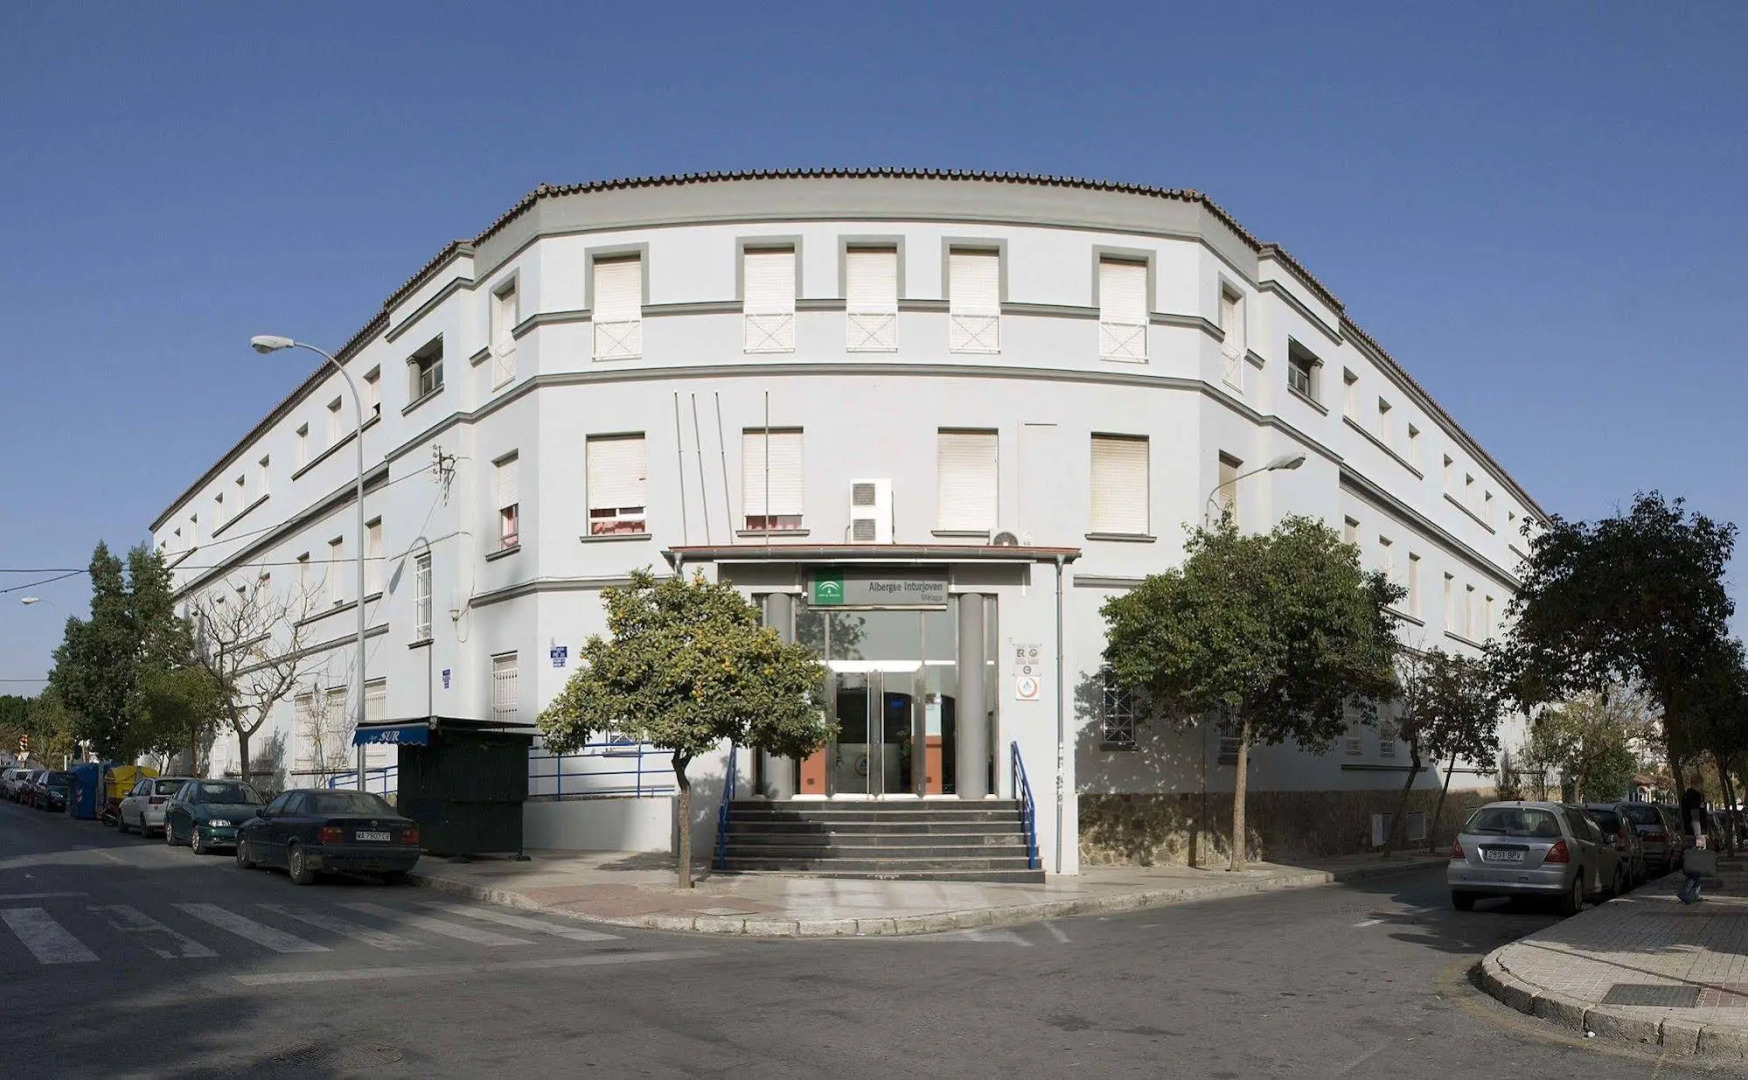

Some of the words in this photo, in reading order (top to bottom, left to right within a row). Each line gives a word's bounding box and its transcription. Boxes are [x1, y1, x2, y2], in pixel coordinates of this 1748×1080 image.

[868, 582, 902, 593] Albergue
[904, 582, 943, 593] Inturjoven
[379, 730, 400, 741] SUR
